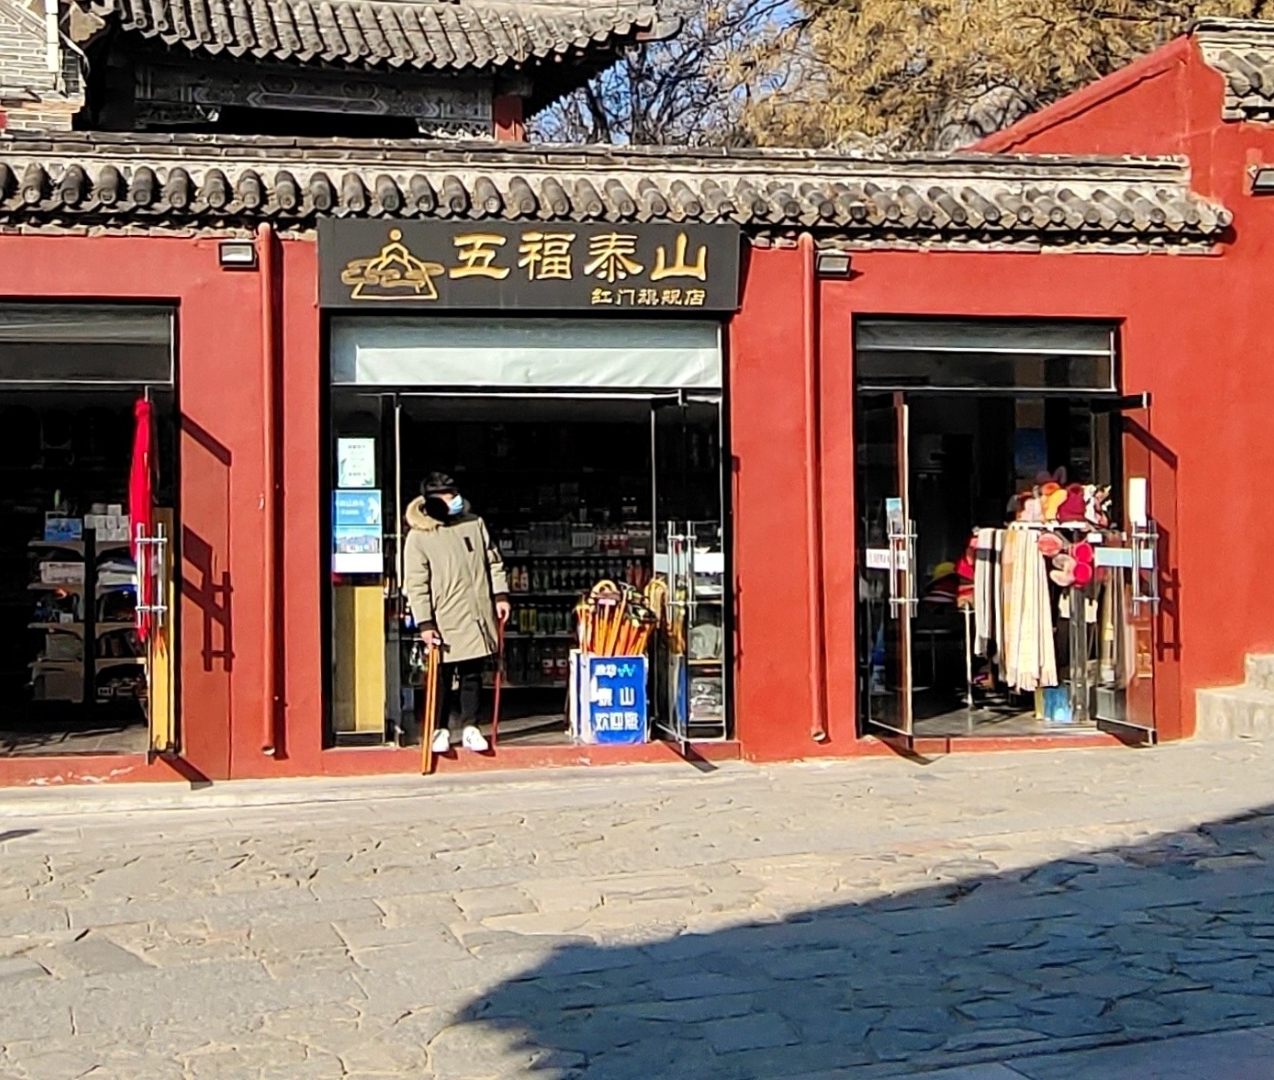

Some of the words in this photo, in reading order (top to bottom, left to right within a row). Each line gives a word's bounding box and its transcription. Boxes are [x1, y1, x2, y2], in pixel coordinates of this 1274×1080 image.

[449, 231, 707, 283] 五福泰山
[591, 287, 706, 307] 红门旗舰店
